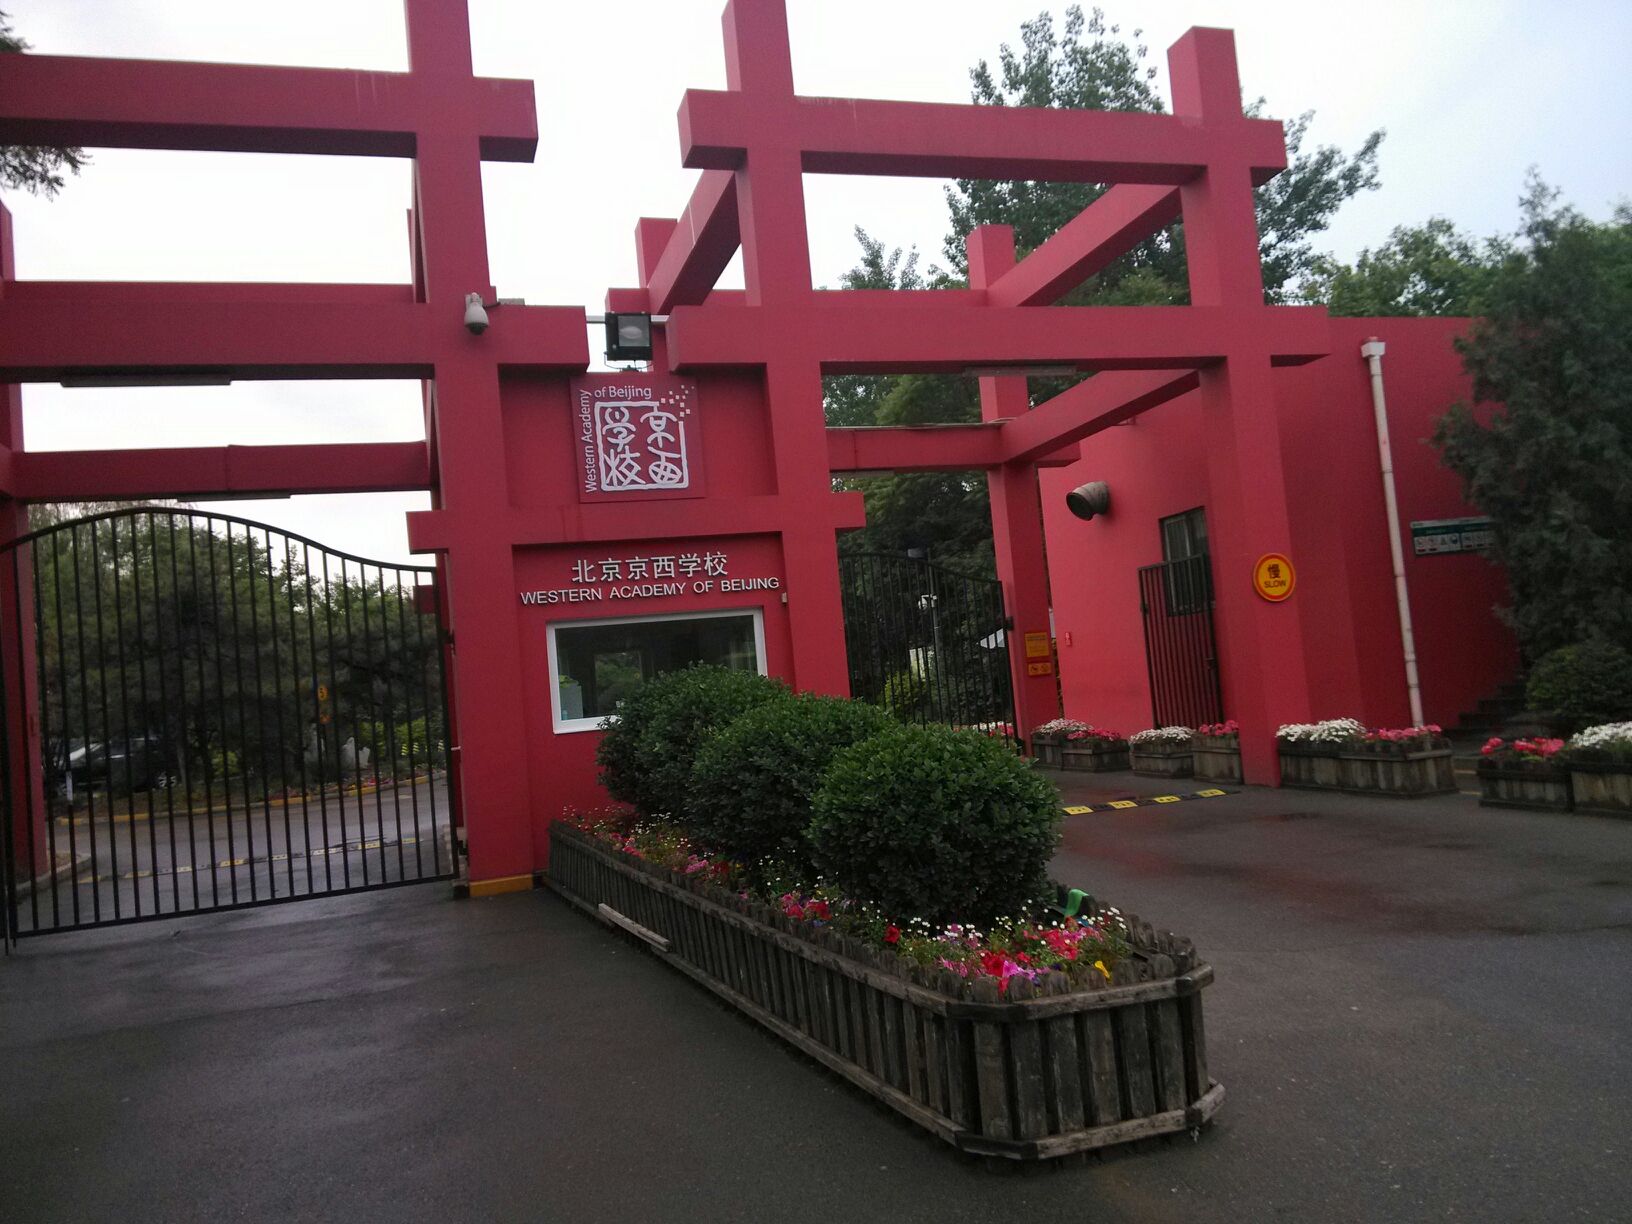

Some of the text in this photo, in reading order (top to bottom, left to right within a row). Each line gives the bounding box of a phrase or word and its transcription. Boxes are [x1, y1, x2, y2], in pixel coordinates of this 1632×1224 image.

[579, 385, 652, 493] Western Academy of Beijing
[571, 551, 729, 583] 北京京西学校
[1267, 563, 1281, 579] 慢
[520, 576, 780, 605] WESTERN ACADEMY OF BEIJING
[1264, 580, 1287, 588] SLOW
